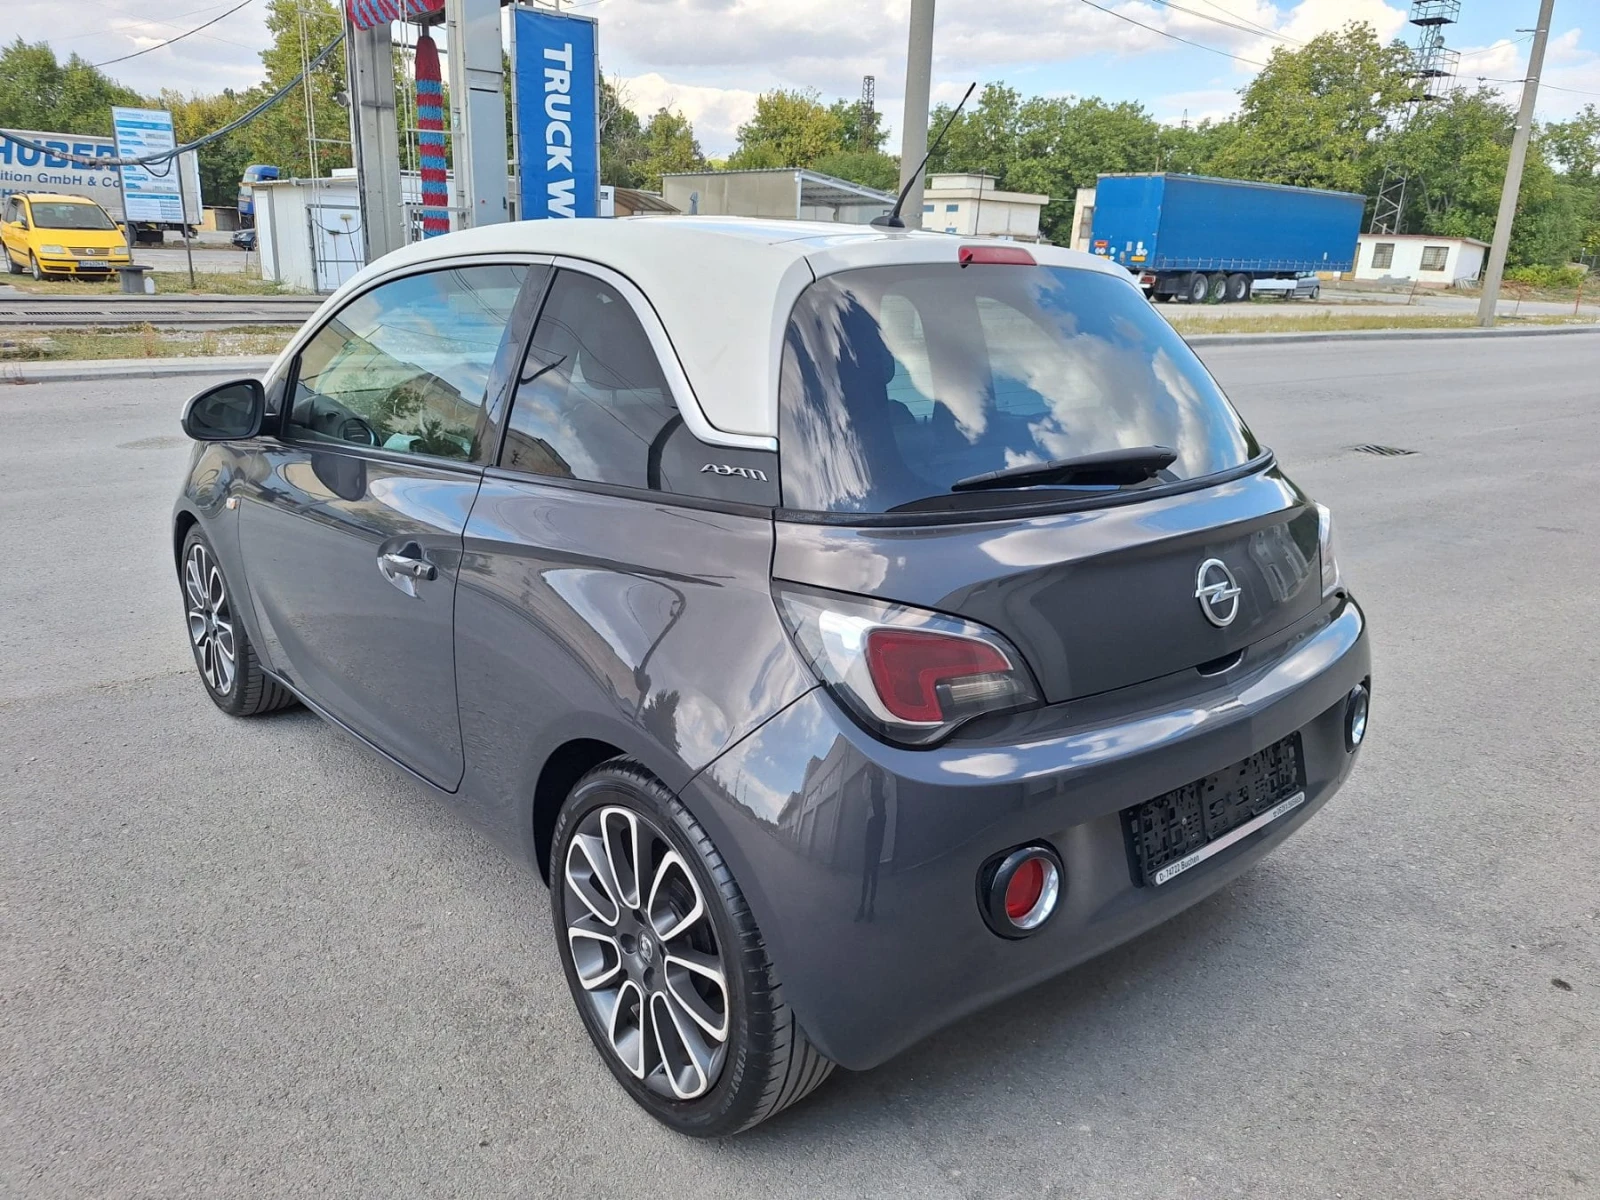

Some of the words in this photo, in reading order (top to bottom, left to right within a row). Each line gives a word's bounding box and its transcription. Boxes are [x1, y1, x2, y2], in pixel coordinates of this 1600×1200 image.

[543, 43, 573, 173] TRUCK
[37, 172, 82, 186] GmbH
[87, 176, 97, 187] &
[547, 178, 576, 219] W
[1180, 855, 1200, 870] Buchen
